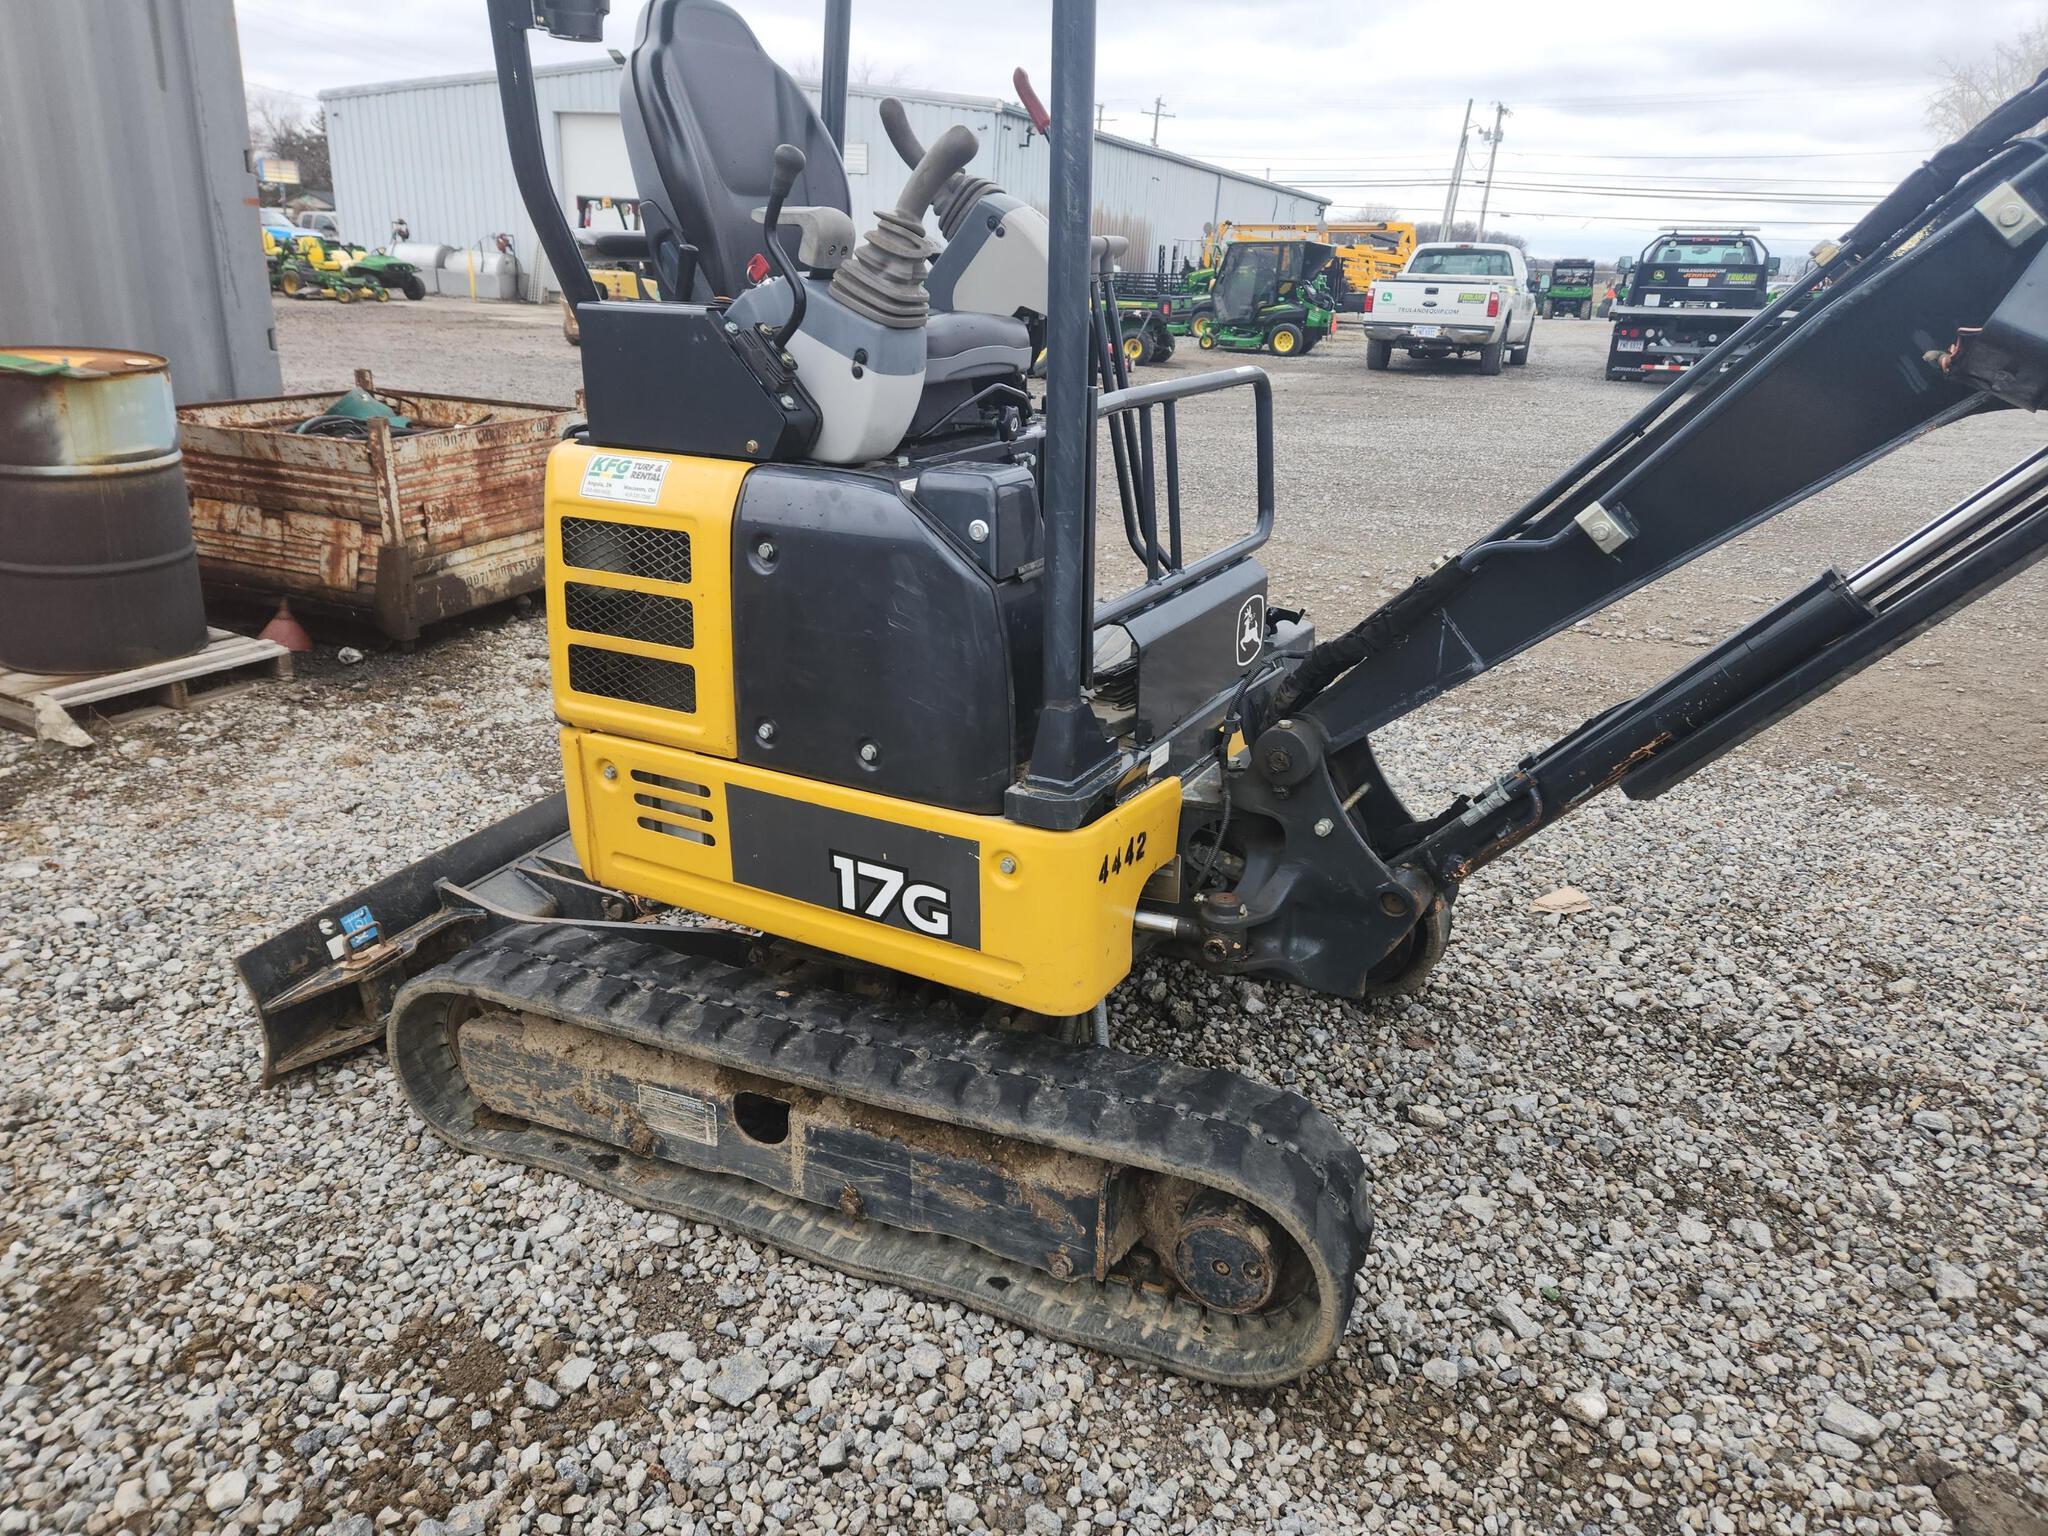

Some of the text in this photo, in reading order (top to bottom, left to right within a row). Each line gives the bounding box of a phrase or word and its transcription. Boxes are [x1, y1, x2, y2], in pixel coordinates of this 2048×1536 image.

[1398, 306, 1459, 315] TRULANDEQUIP.COM
[591, 456, 632, 474] KFG
[633, 462, 663, 473] TURF &
[630, 471, 661, 482] RENTAL
[1098, 830, 1147, 885] 4442
[830, 850, 951, 937] 17G
